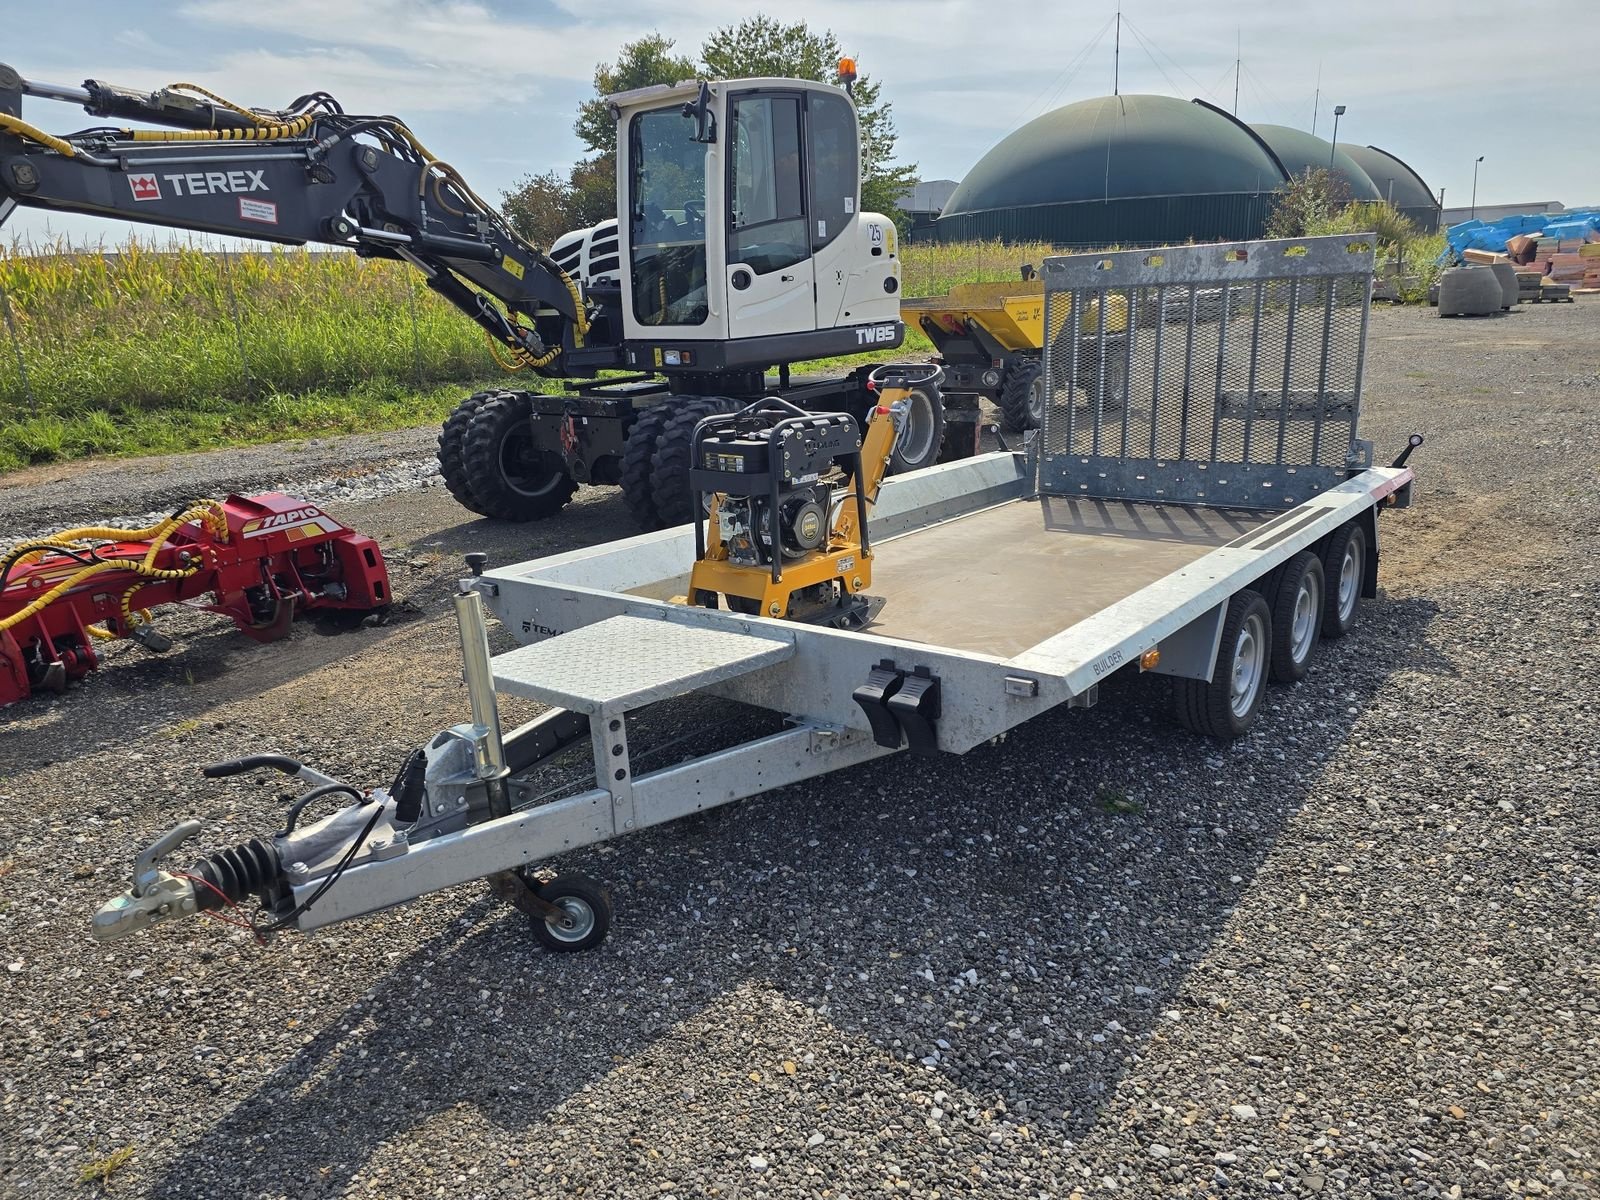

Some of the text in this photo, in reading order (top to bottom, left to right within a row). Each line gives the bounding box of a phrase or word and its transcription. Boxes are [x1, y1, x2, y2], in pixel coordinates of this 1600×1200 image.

[164, 170, 270, 196] TEREX
[869, 224, 881, 241] 25
[855, 325, 896, 345] TW85
[263, 507, 320, 528] TAPIO
[1093, 650, 1124, 676] BUILDER
